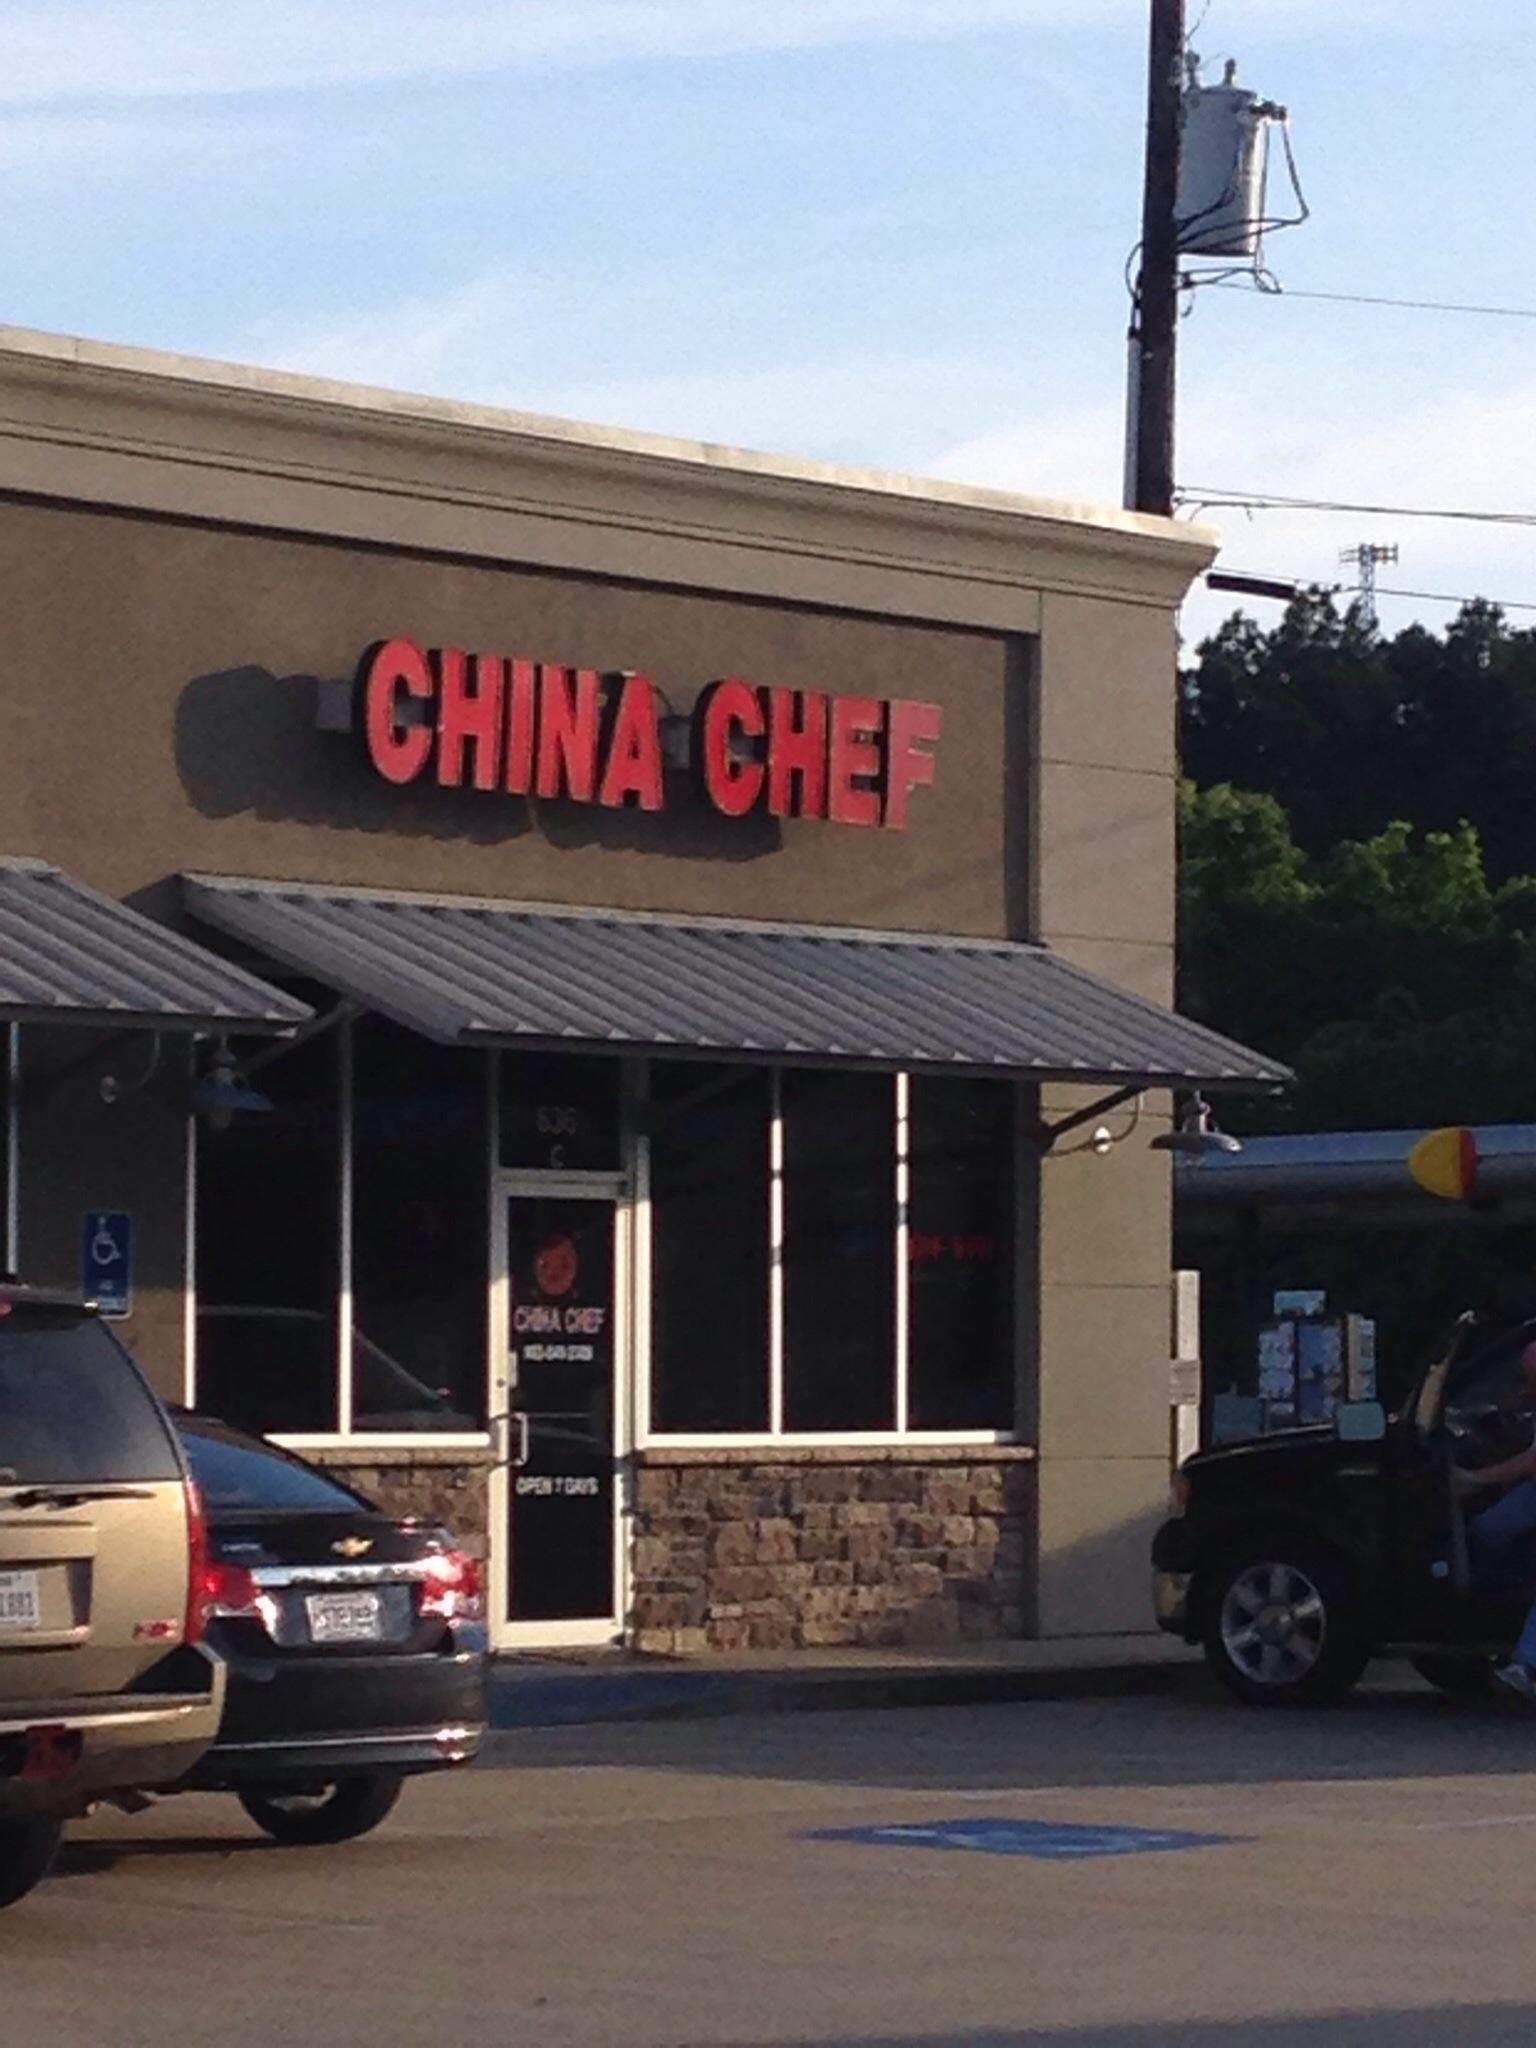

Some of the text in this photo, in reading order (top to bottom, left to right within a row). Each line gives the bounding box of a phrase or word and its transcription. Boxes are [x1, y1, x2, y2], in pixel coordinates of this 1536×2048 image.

[361, 635, 942, 829] CHINA CHEF
[516, 1476, 552, 1495] OPEN
[565, 1476, 599, 1495] DAYS
